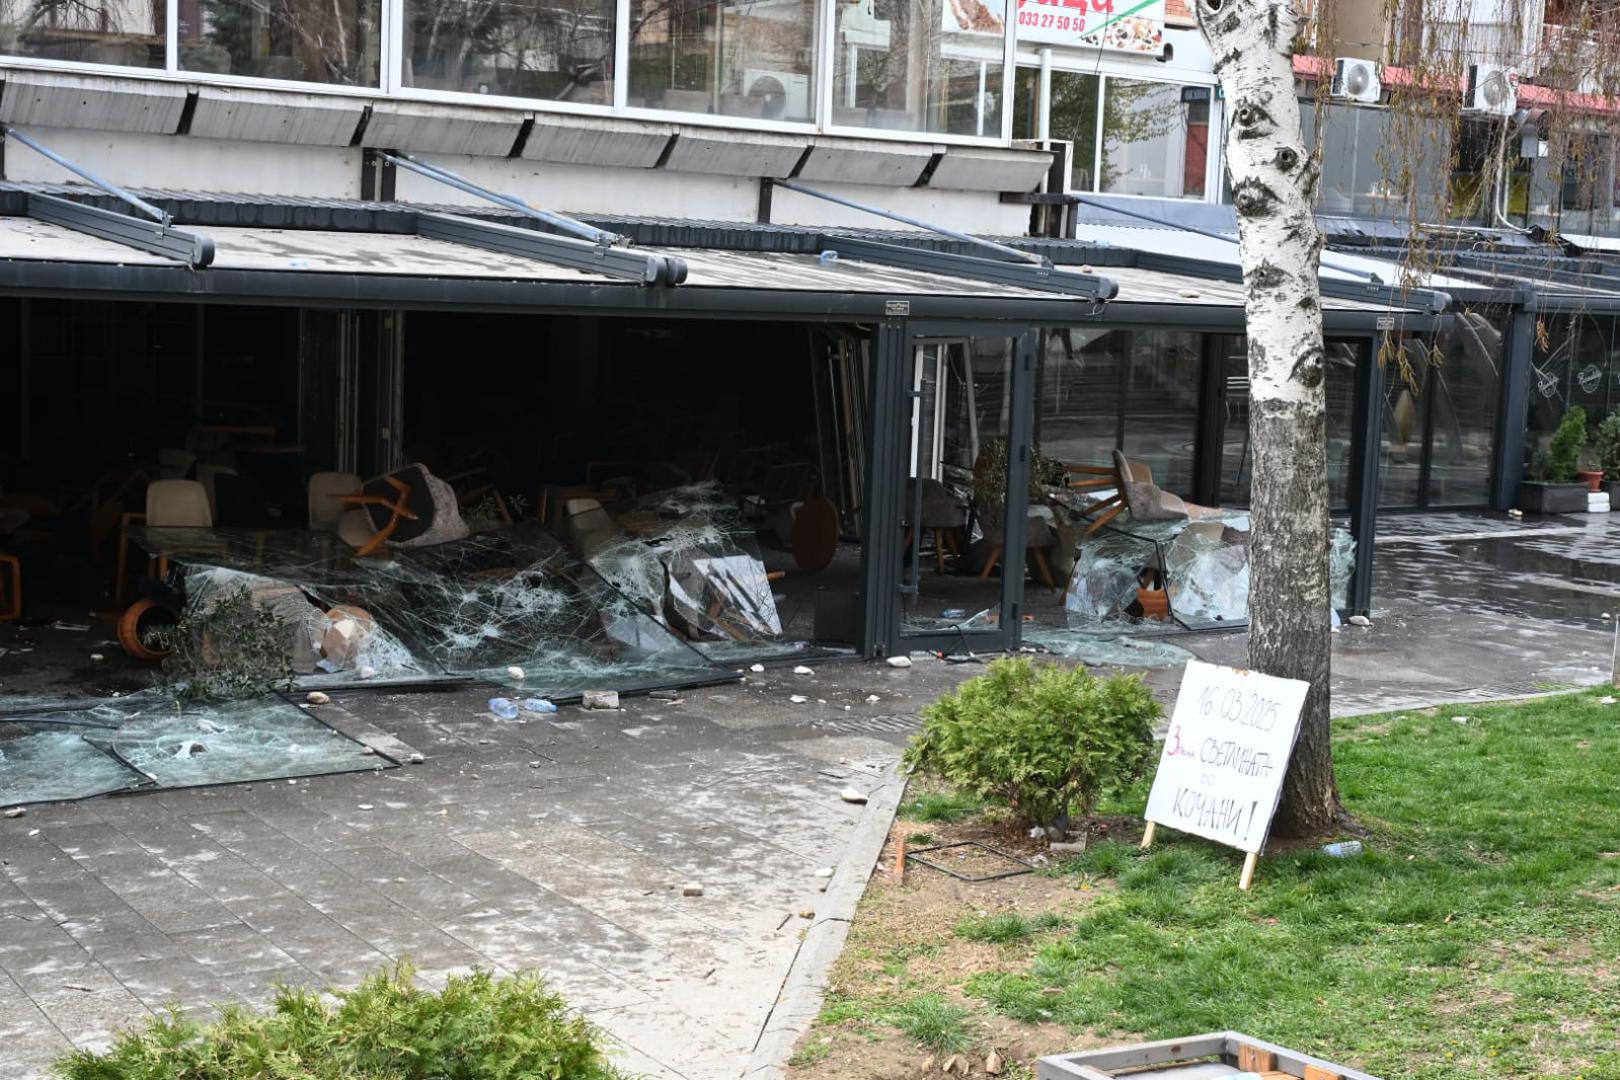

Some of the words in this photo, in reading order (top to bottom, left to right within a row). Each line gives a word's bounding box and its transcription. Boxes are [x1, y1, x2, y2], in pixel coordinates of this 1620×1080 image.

[1019, 11, 1039, 27] 033
[1041, 14, 1055, 28] 27
[1057, 16, 1070, 31] 50
[1072, 18, 1086, 32] 50
